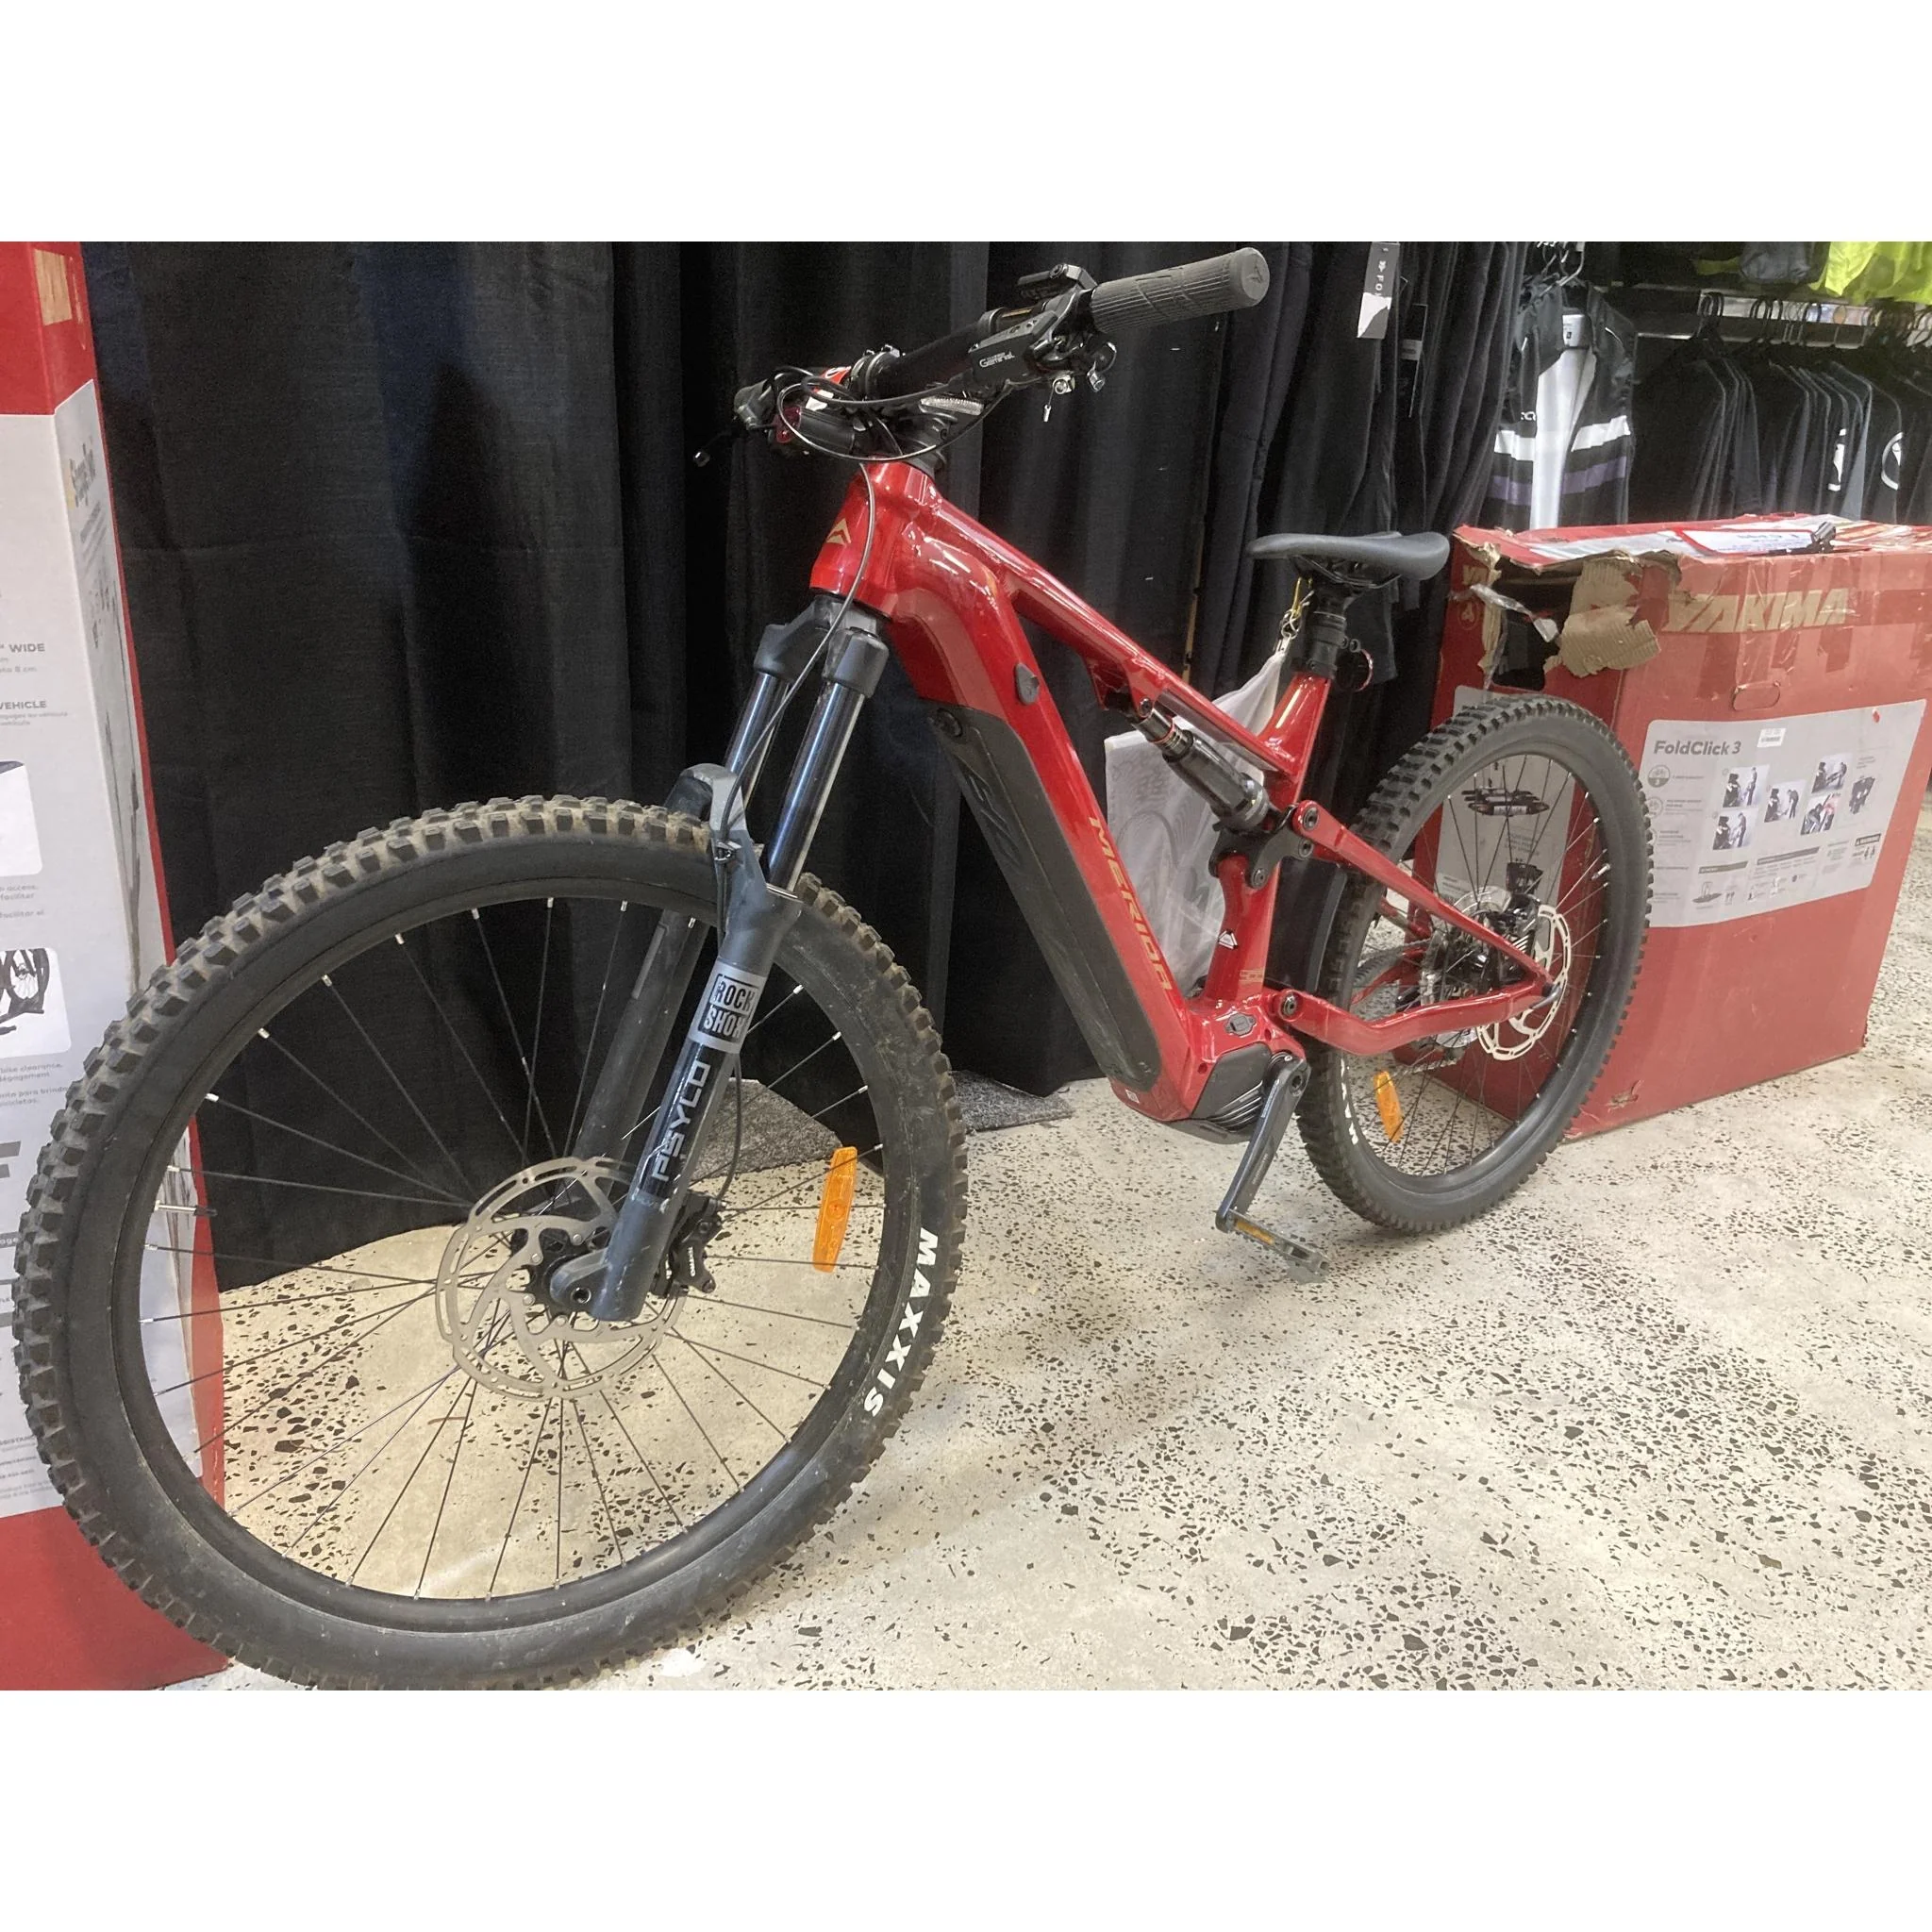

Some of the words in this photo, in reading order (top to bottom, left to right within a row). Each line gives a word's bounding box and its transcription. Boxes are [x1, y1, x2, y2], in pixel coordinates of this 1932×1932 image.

[1661, 589, 1849, 633] YAKIMA
[9, 643, 45, 653] WIDE
[1654, 740, 1730, 756] FoldClick
[1732, 741, 1741, 755] 3
[1089, 817, 1173, 990] MERIDA
[717, 981, 756, 1013] ROCK
[652, 1062, 710, 1181] PSYLO
[864, 1227, 939, 1418] MAXXIS
